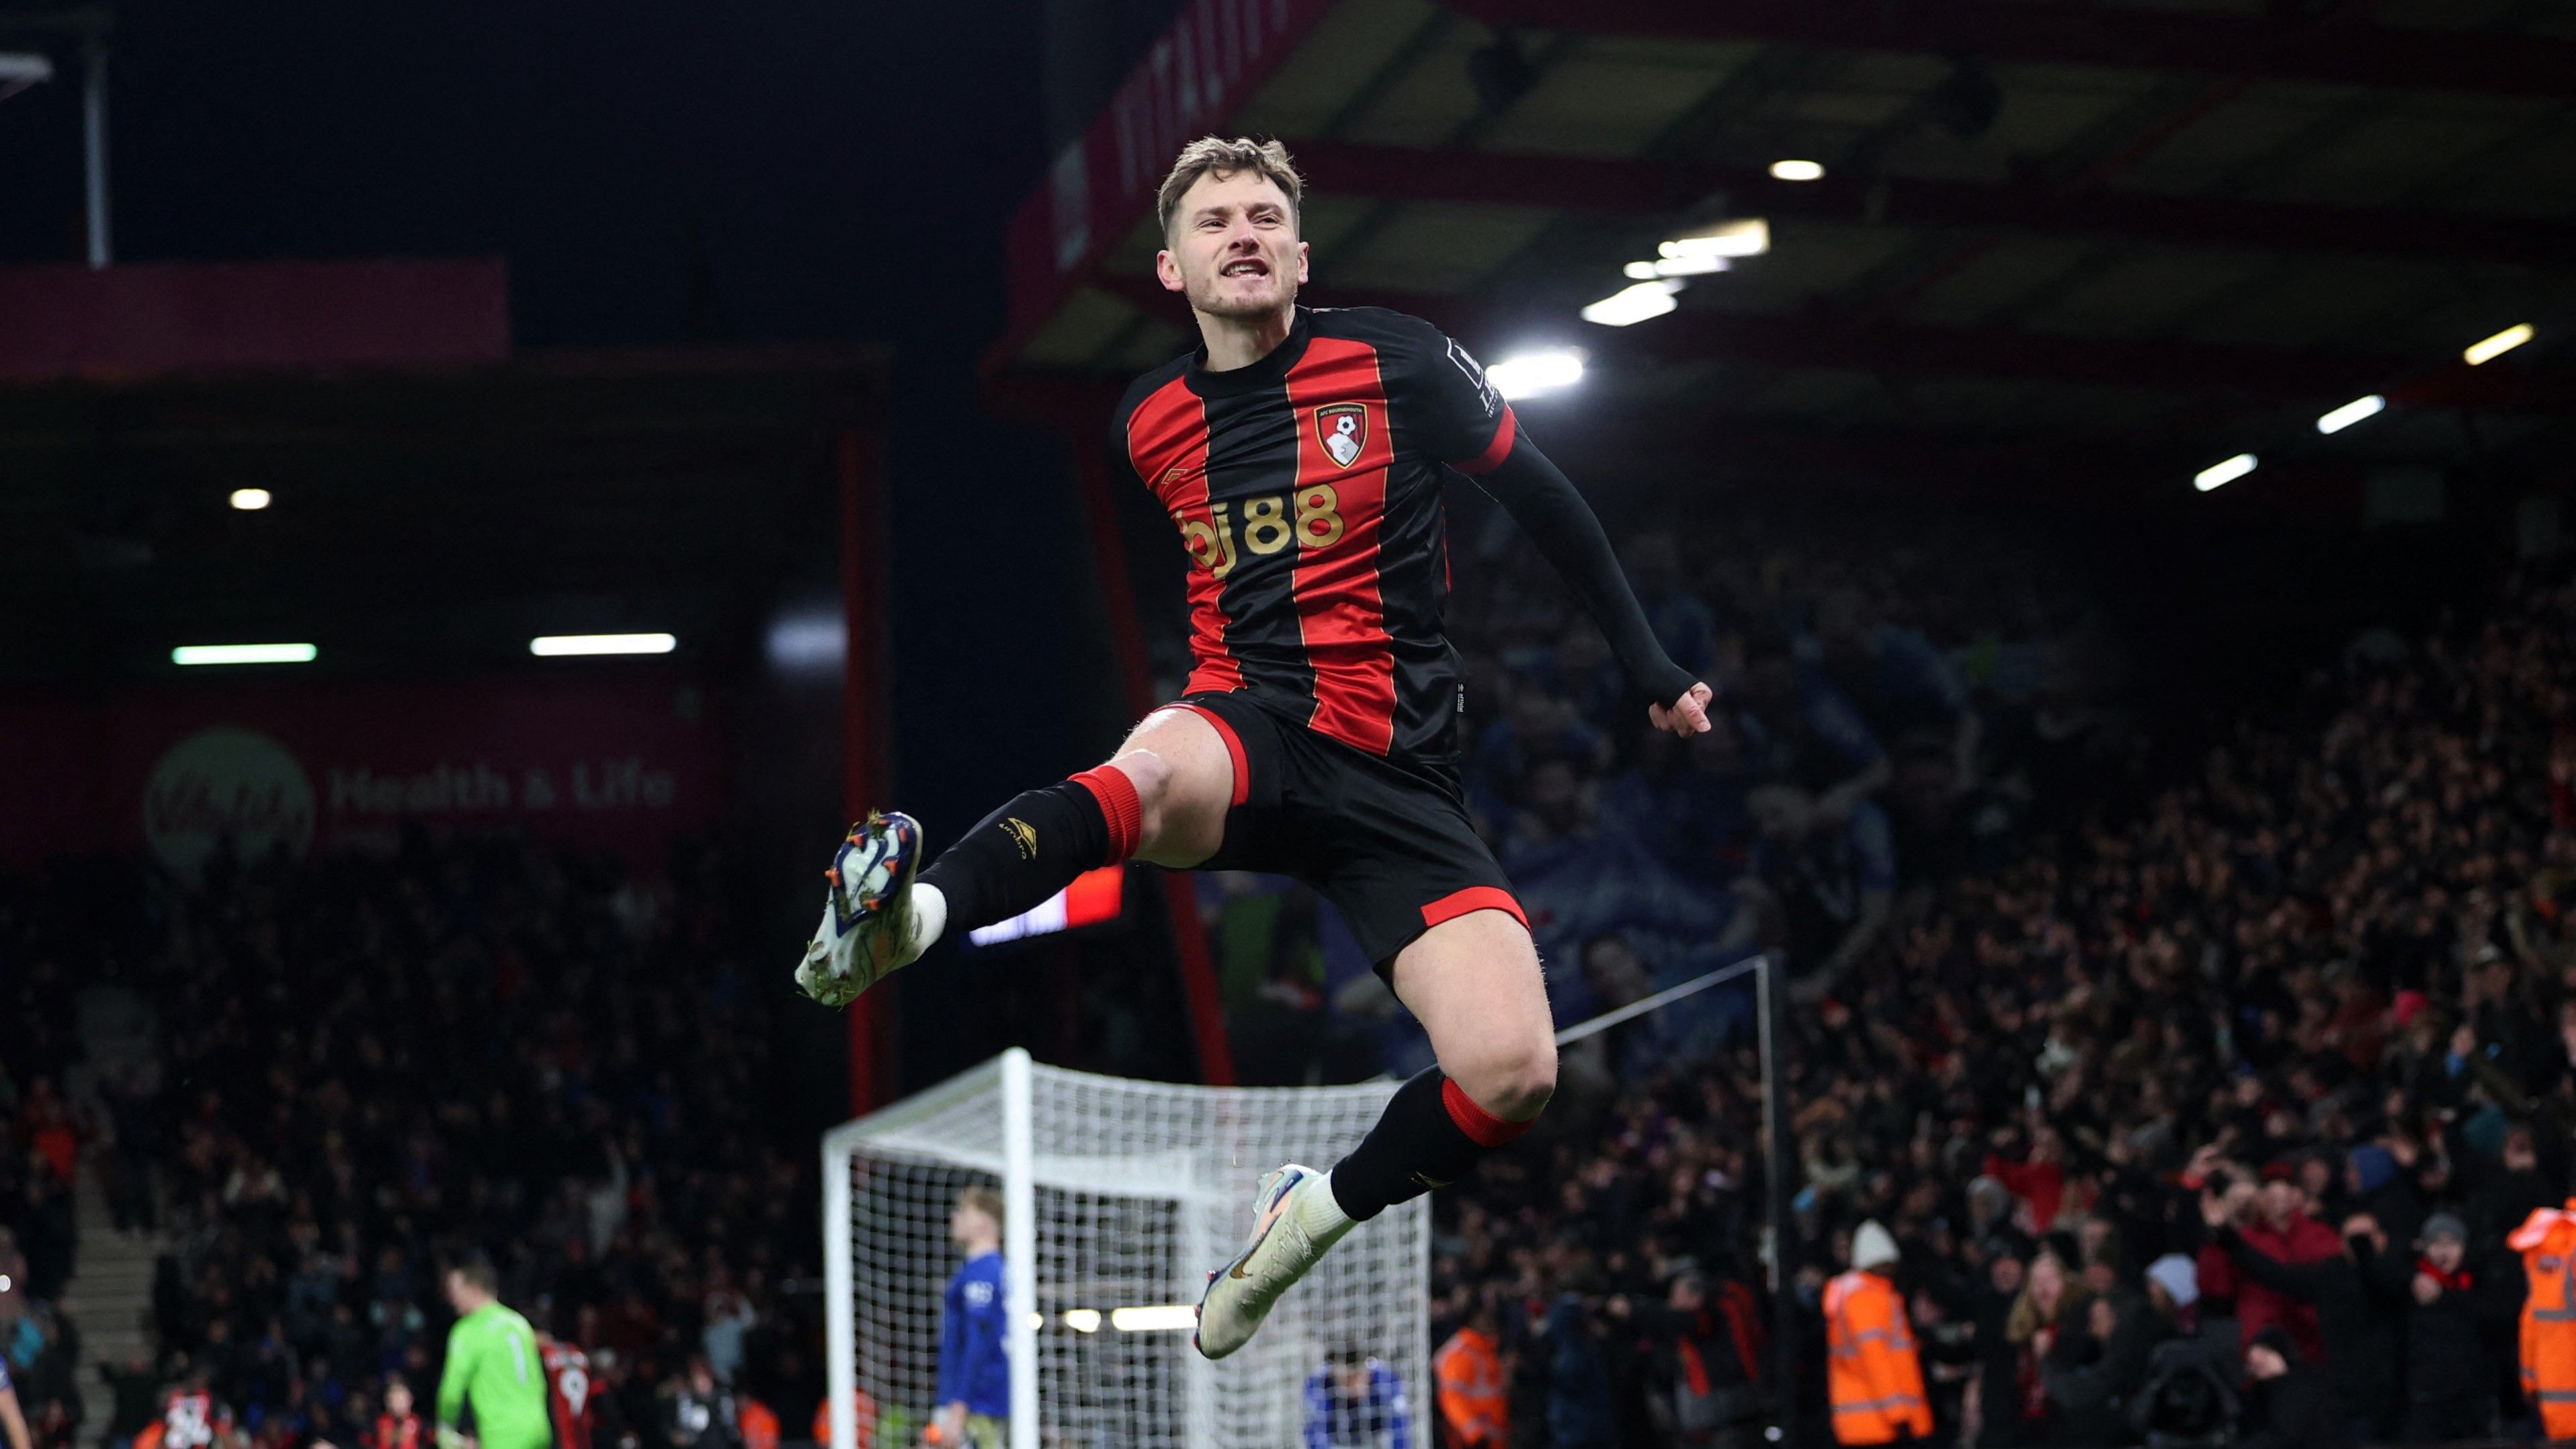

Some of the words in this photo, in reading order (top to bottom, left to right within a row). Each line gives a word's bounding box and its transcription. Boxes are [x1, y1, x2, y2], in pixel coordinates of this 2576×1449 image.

[1175, 484, 1344, 579] bj88
[327, 760, 511, 812] Health
[522, 765, 557, 811] &
[569, 753, 676, 810] Life
[558, 1366, 589, 1417] 9
